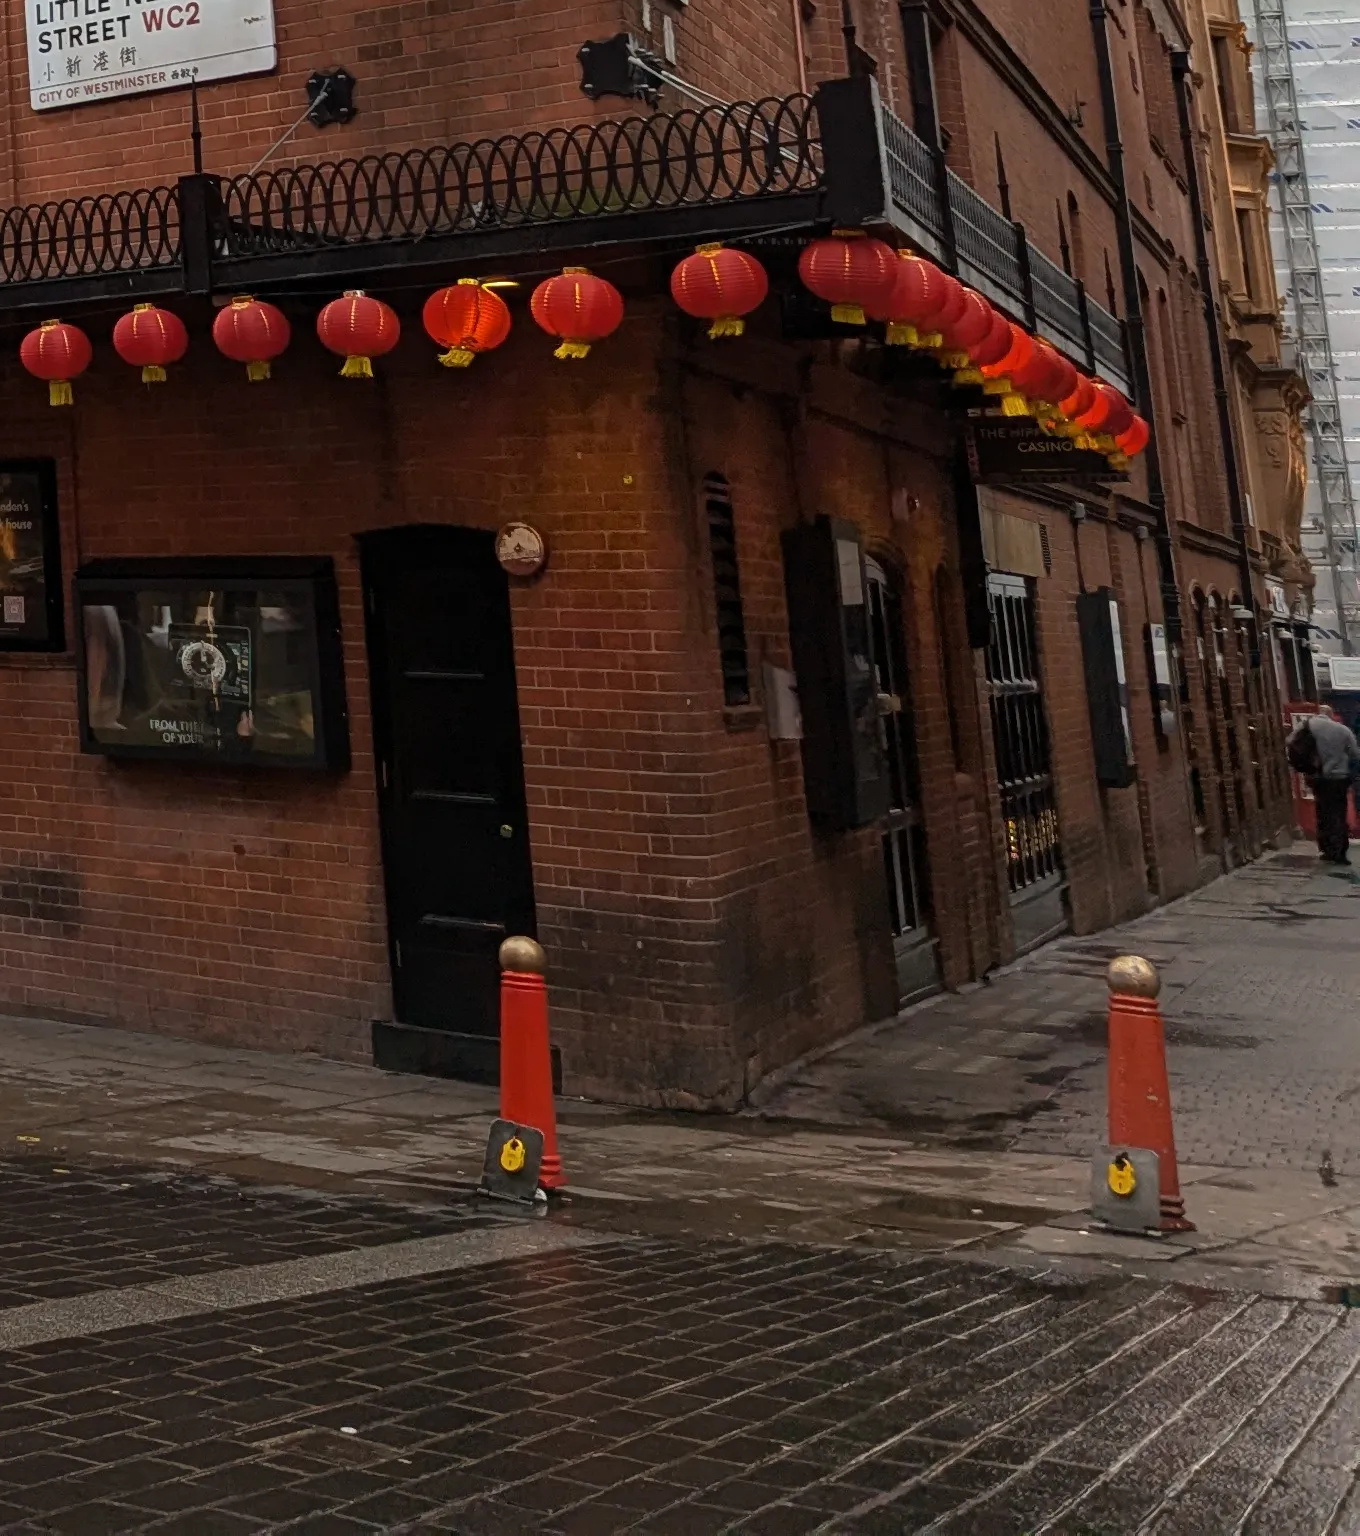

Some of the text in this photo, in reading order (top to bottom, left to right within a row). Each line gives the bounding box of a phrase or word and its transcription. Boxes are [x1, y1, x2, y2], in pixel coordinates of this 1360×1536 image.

[38, 1, 201, 53] STREET WC2
[41, 46, 137, 83] 小新港街
[38, 71, 167, 104] CITY OF WESTMINSTER
[980, 427, 1006, 440] THE
[1017, 440, 1073, 453] CASINO
[6, 517, 33, 531] house
[149, 719, 179, 732] FROM
[162, 731, 176, 744] OF
